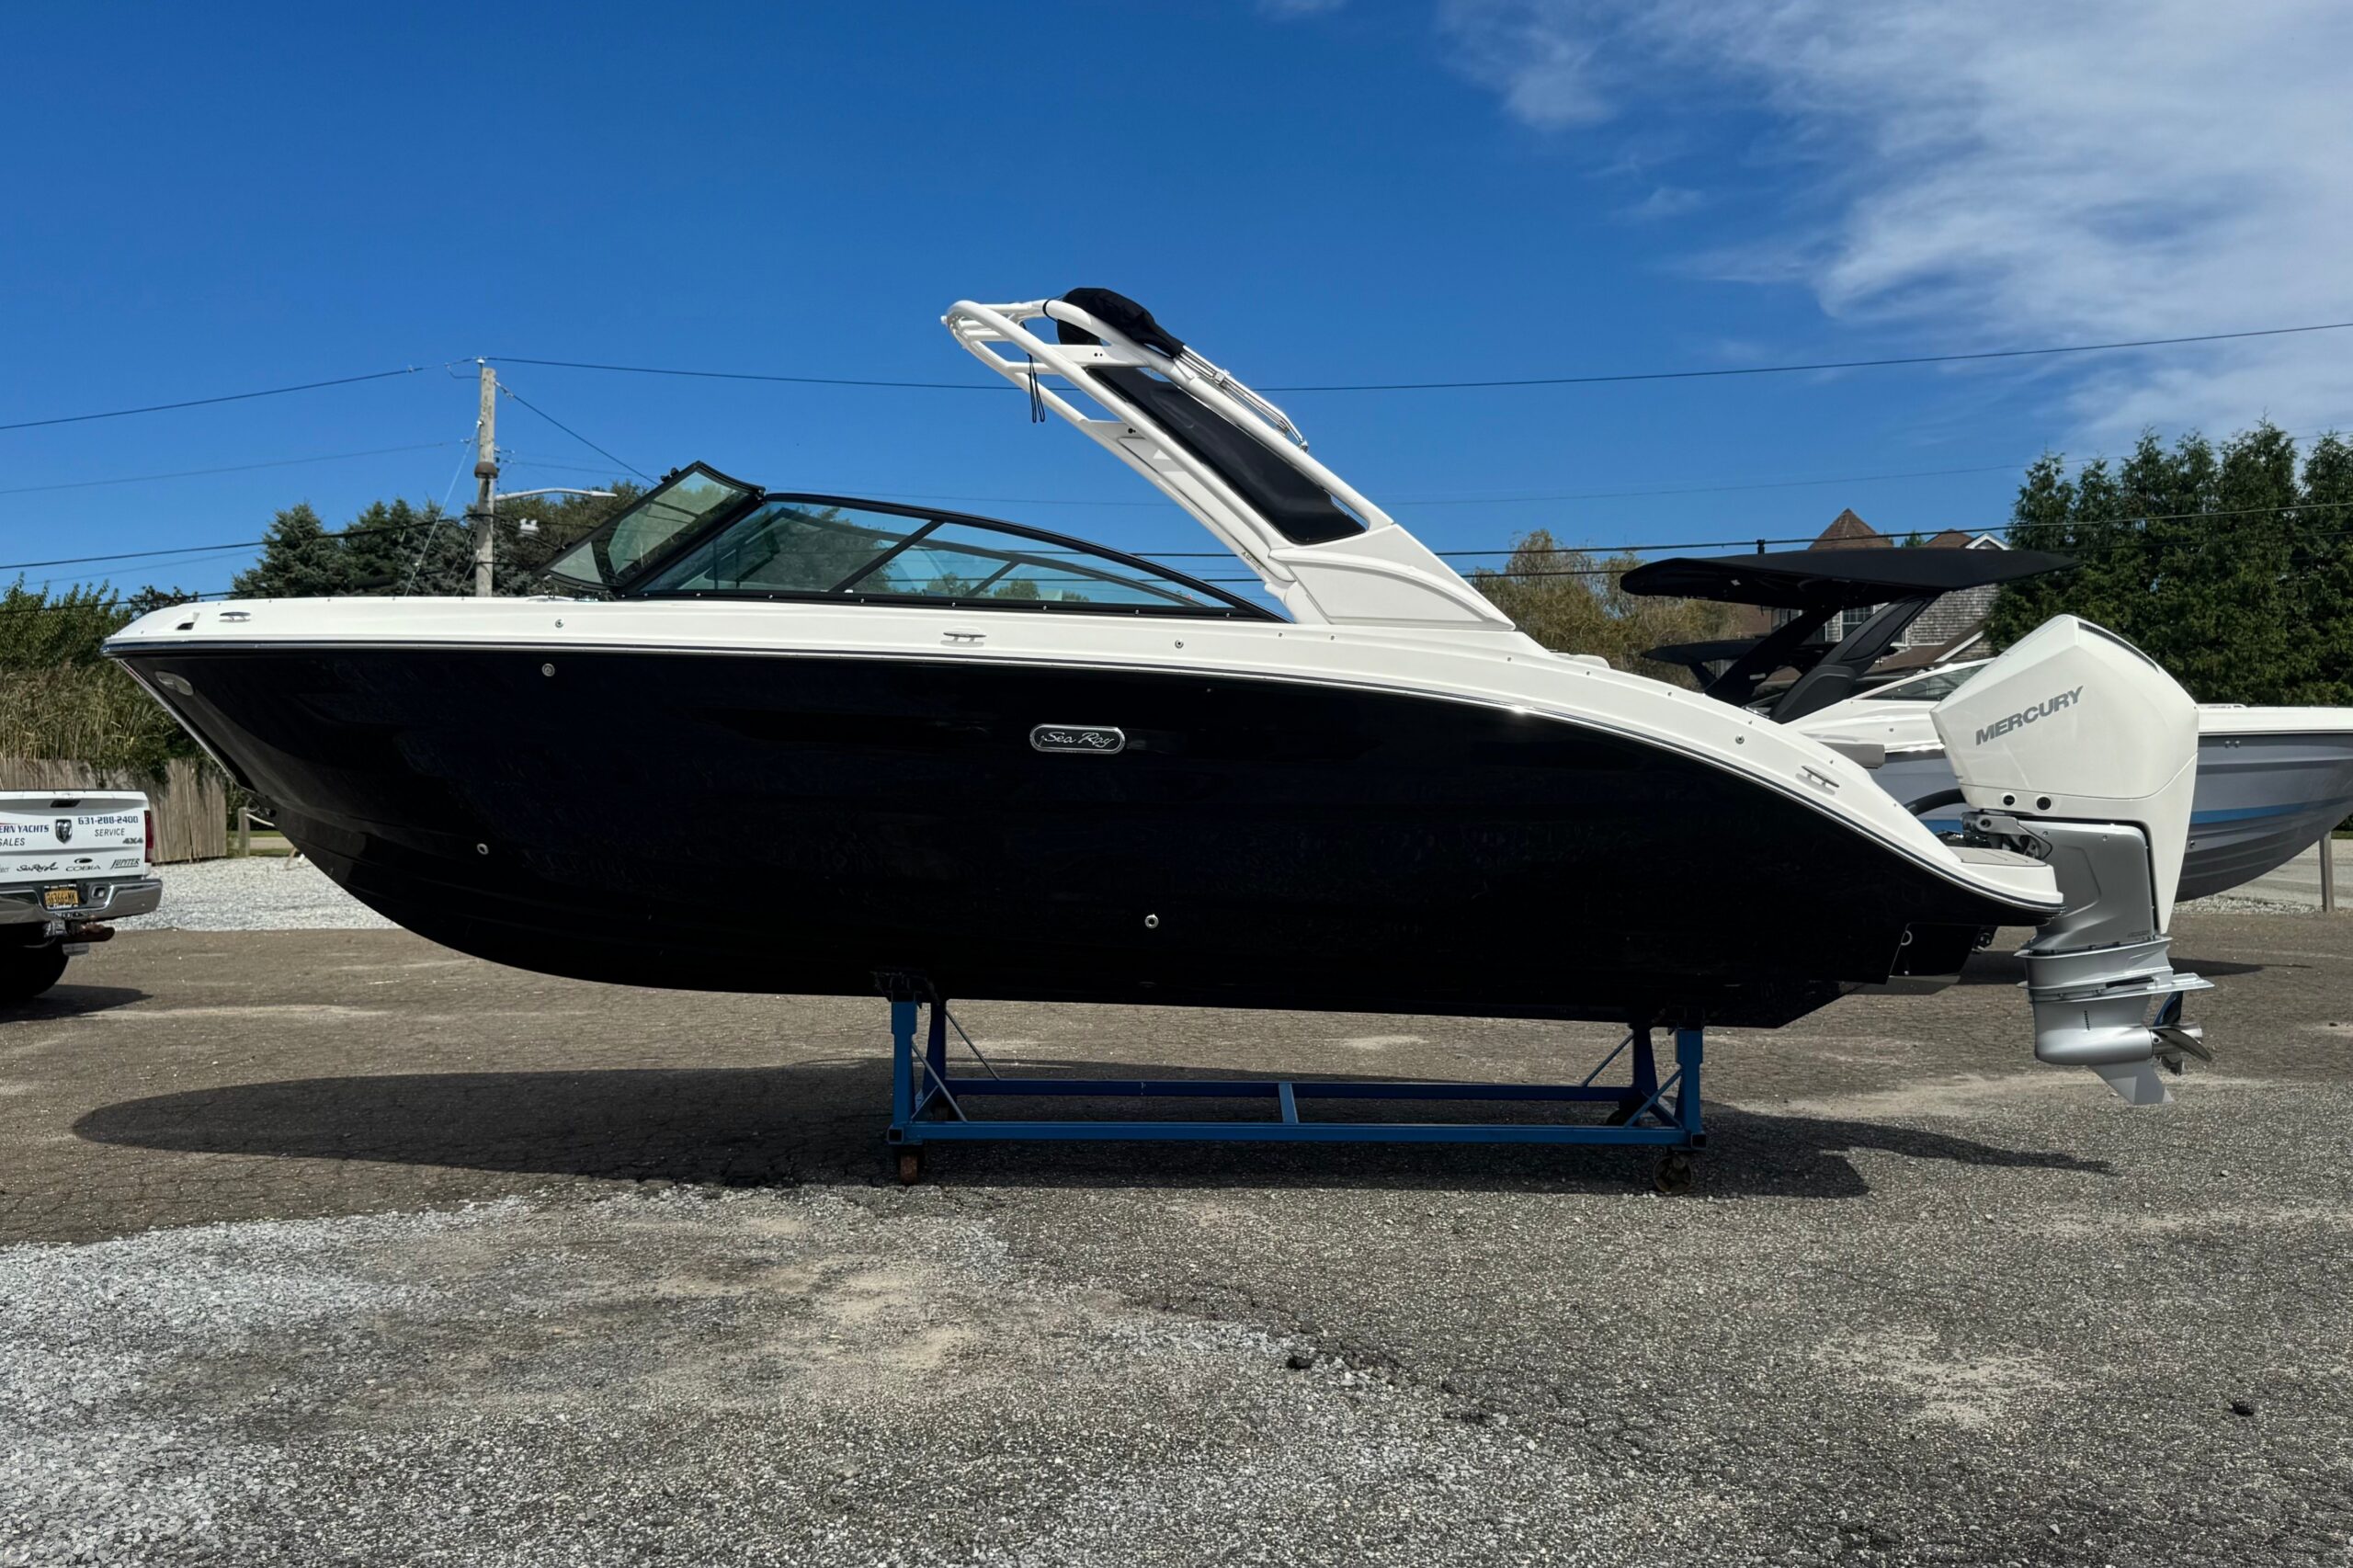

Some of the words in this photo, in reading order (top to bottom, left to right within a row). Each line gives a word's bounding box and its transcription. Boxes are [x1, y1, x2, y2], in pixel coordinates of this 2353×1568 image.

[1975, 685, 2085, 745] MERCURY
[1045, 731, 1076, 744] Sea
[1077, 732, 1115, 748] Ray
[77, 815, 139, 825] 631-288-2400
[17, 824, 50, 833] YACHTS
[95, 828, 126, 837] SERVICE
[109, 858, 141, 870] JUPITER
